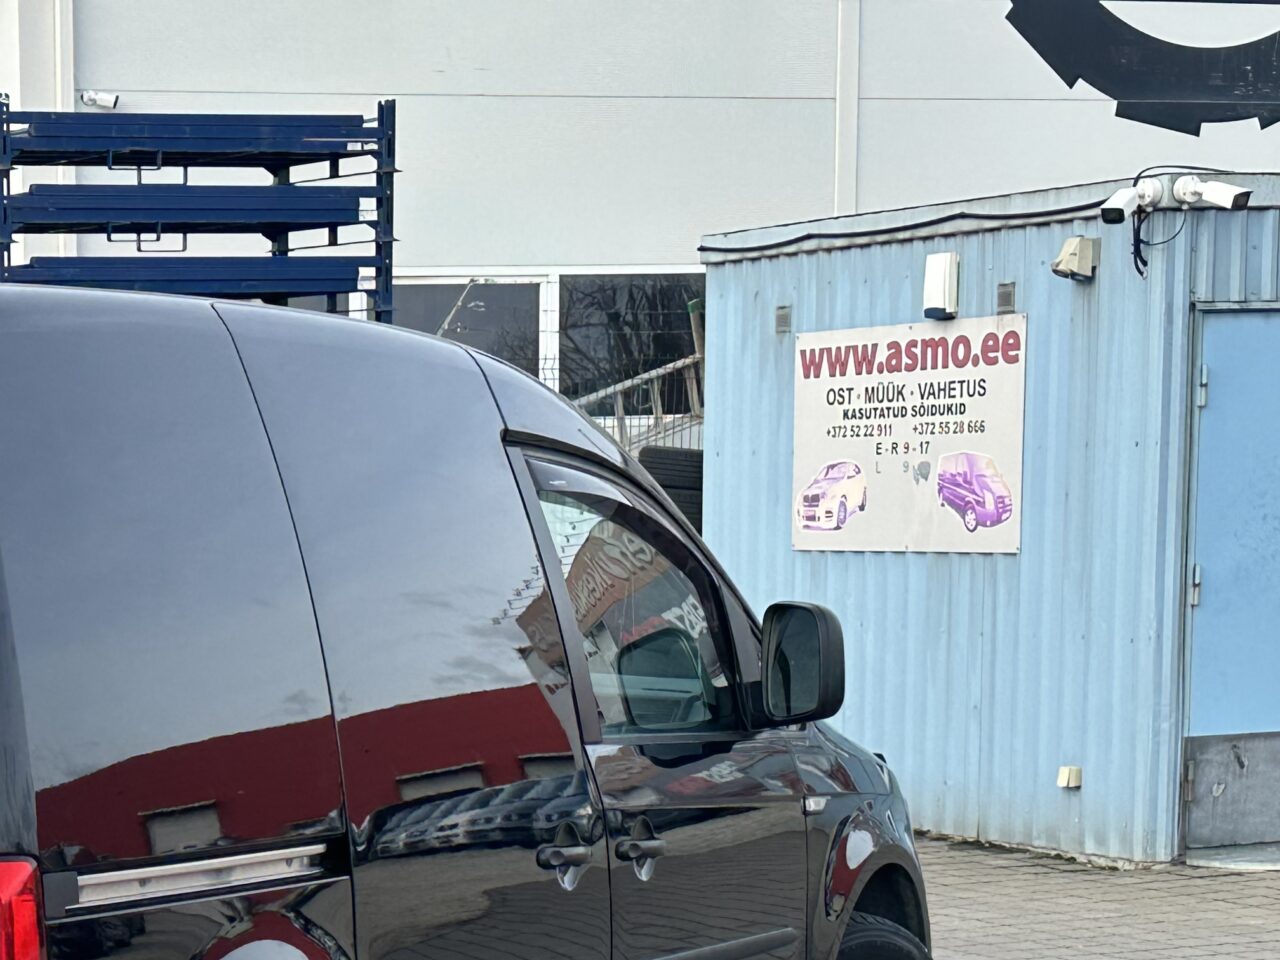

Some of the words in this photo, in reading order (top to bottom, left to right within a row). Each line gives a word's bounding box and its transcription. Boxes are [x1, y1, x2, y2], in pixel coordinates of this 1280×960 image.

[799, 330, 1022, 379] www.asmo.ee
[826, 387, 854, 405] OST
[864, 381, 906, 402] MÜÜK
[918, 378, 987, 400] VAHETUS
[842, 406, 908, 421] KASUTATUD
[910, 401, 966, 417] SÕIDUKID
[826, 425, 847, 438] +372
[849, 424, 862, 437] 52
[863, 424, 875, 437] 22
[876, 423, 892, 437] 911
[912, 422, 936, 436] +372
[938, 421, 950, 434] 55
[952, 421, 965, 434] 28
[875, 443, 882, 455] E
[891, 442, 898, 455] R
[903, 442, 910, 454] 9
[919, 441, 930, 454] 17
